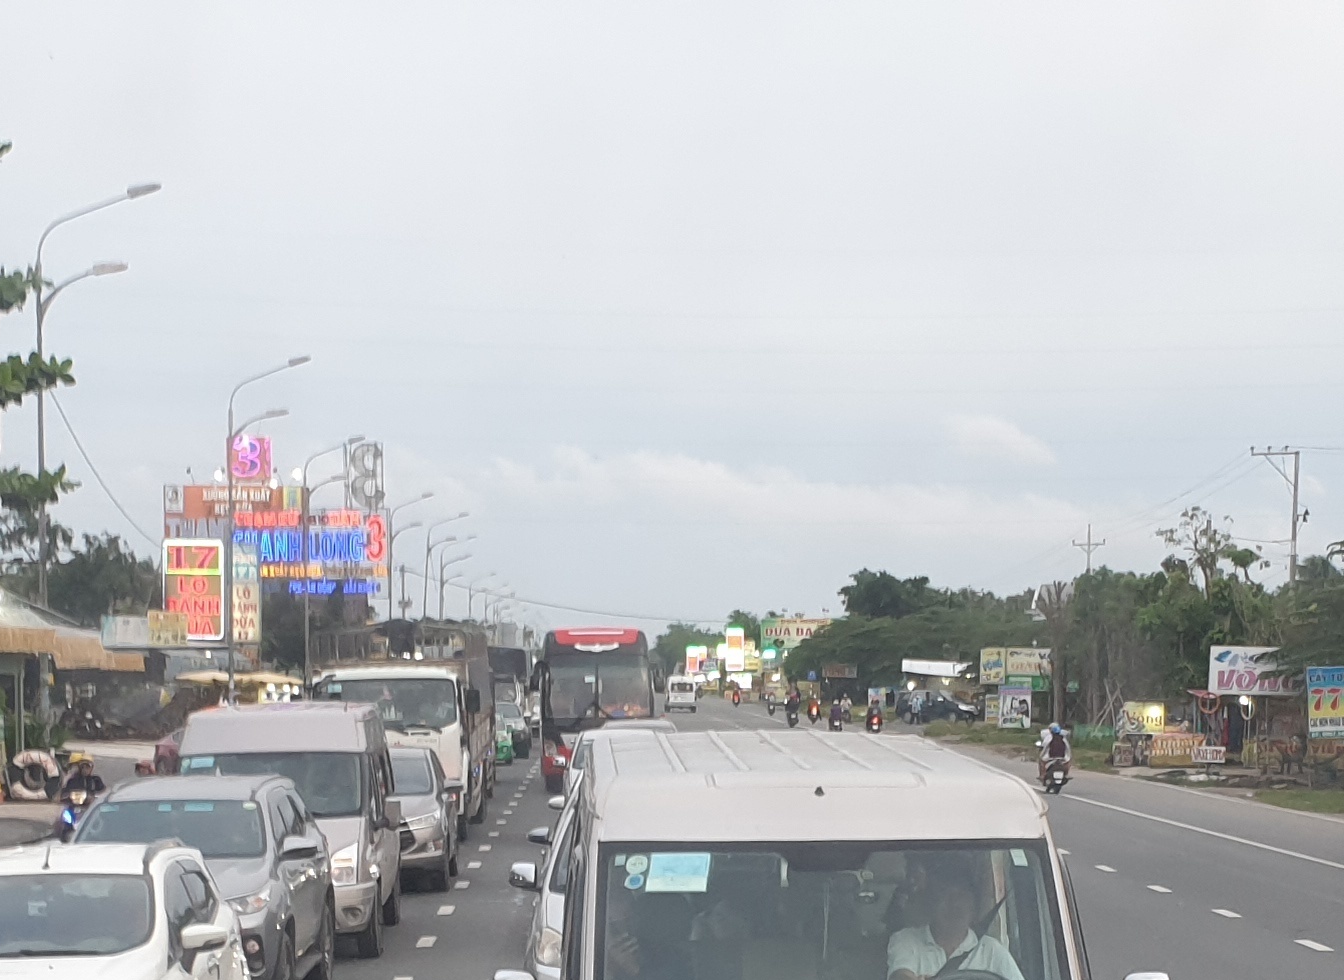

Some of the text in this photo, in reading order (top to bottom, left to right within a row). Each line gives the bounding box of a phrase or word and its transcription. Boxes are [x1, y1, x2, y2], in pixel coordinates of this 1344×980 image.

[260, 530, 303, 562] ANH
[308, 531, 363, 562] LONG
[366, 514, 387, 562] 3
[168, 546, 217, 570] 17
